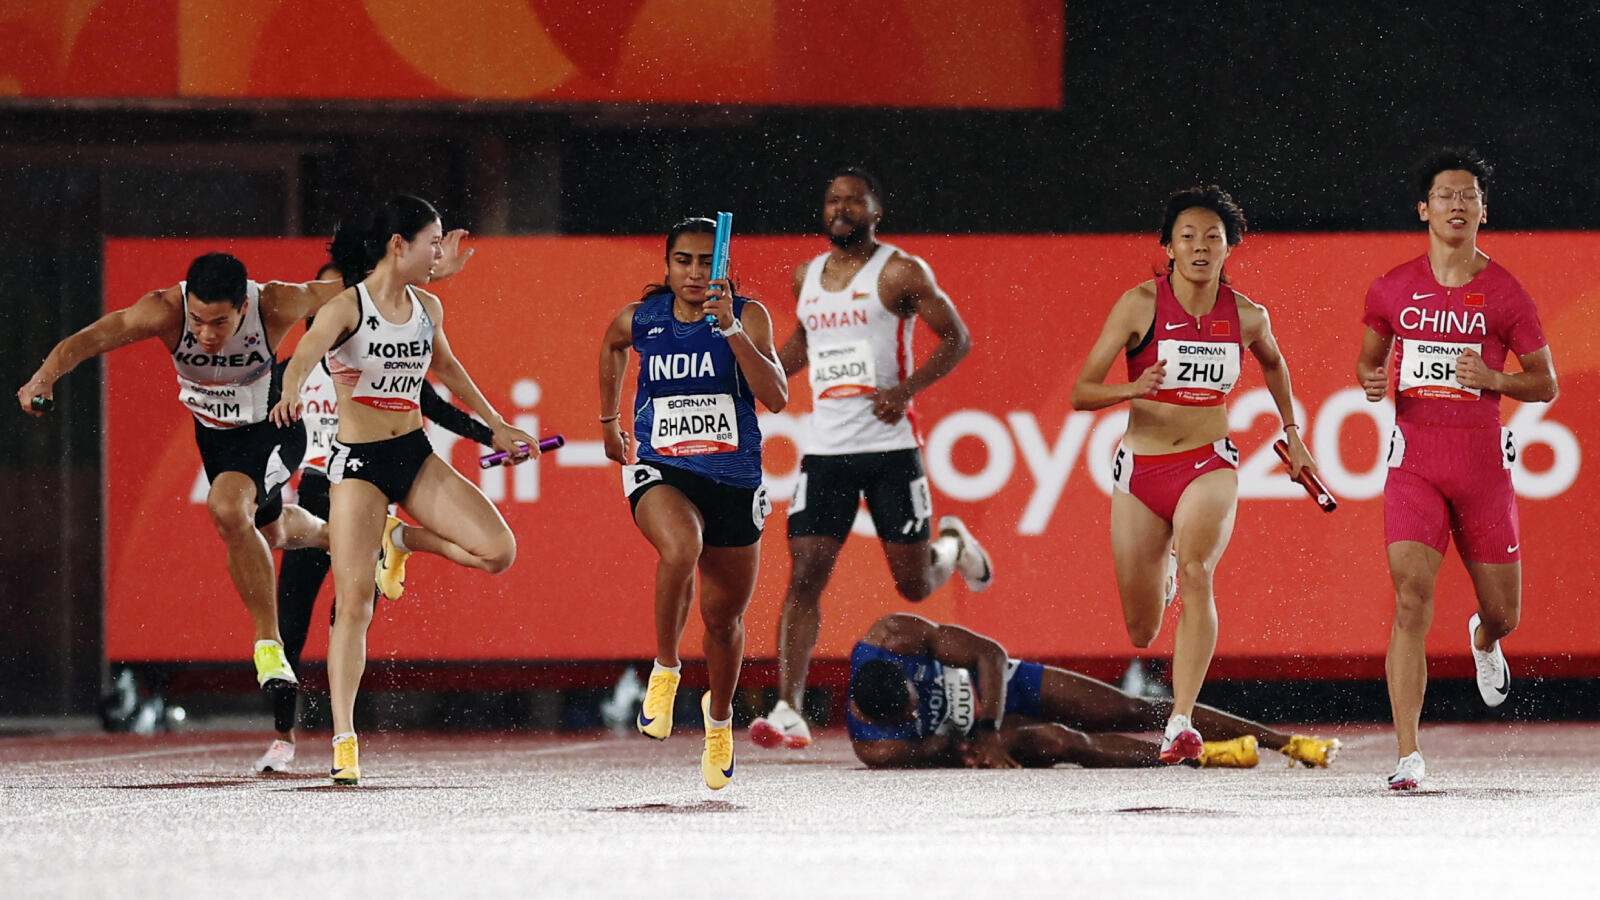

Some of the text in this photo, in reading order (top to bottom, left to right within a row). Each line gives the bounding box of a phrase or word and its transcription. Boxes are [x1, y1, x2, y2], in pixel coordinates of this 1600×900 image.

[806, 310, 868, 330] OMAN
[1400, 306, 1487, 336] CHINA
[176, 350, 264, 367] KOREA
[368, 339, 432, 358] KOREA
[1177, 345, 1226, 355] BORNAN
[384, 361, 424, 369] BORNAN
[649, 351, 715, 381] INDIA
[815, 361, 867, 382] ALSADI
[1177, 362, 1224, 382] ZHU
[1413, 363, 1457, 380] J.SH
[371, 376, 422, 393] J.KIM
[667, 398, 716, 409] BORNAN
[658, 413, 730, 437] BHADRA
[716, 432, 732, 441] 808
[1228, 386, 1581, 500] 206
[327, 445, 341, 475] 7
[1113, 448, 1125, 481] 5
